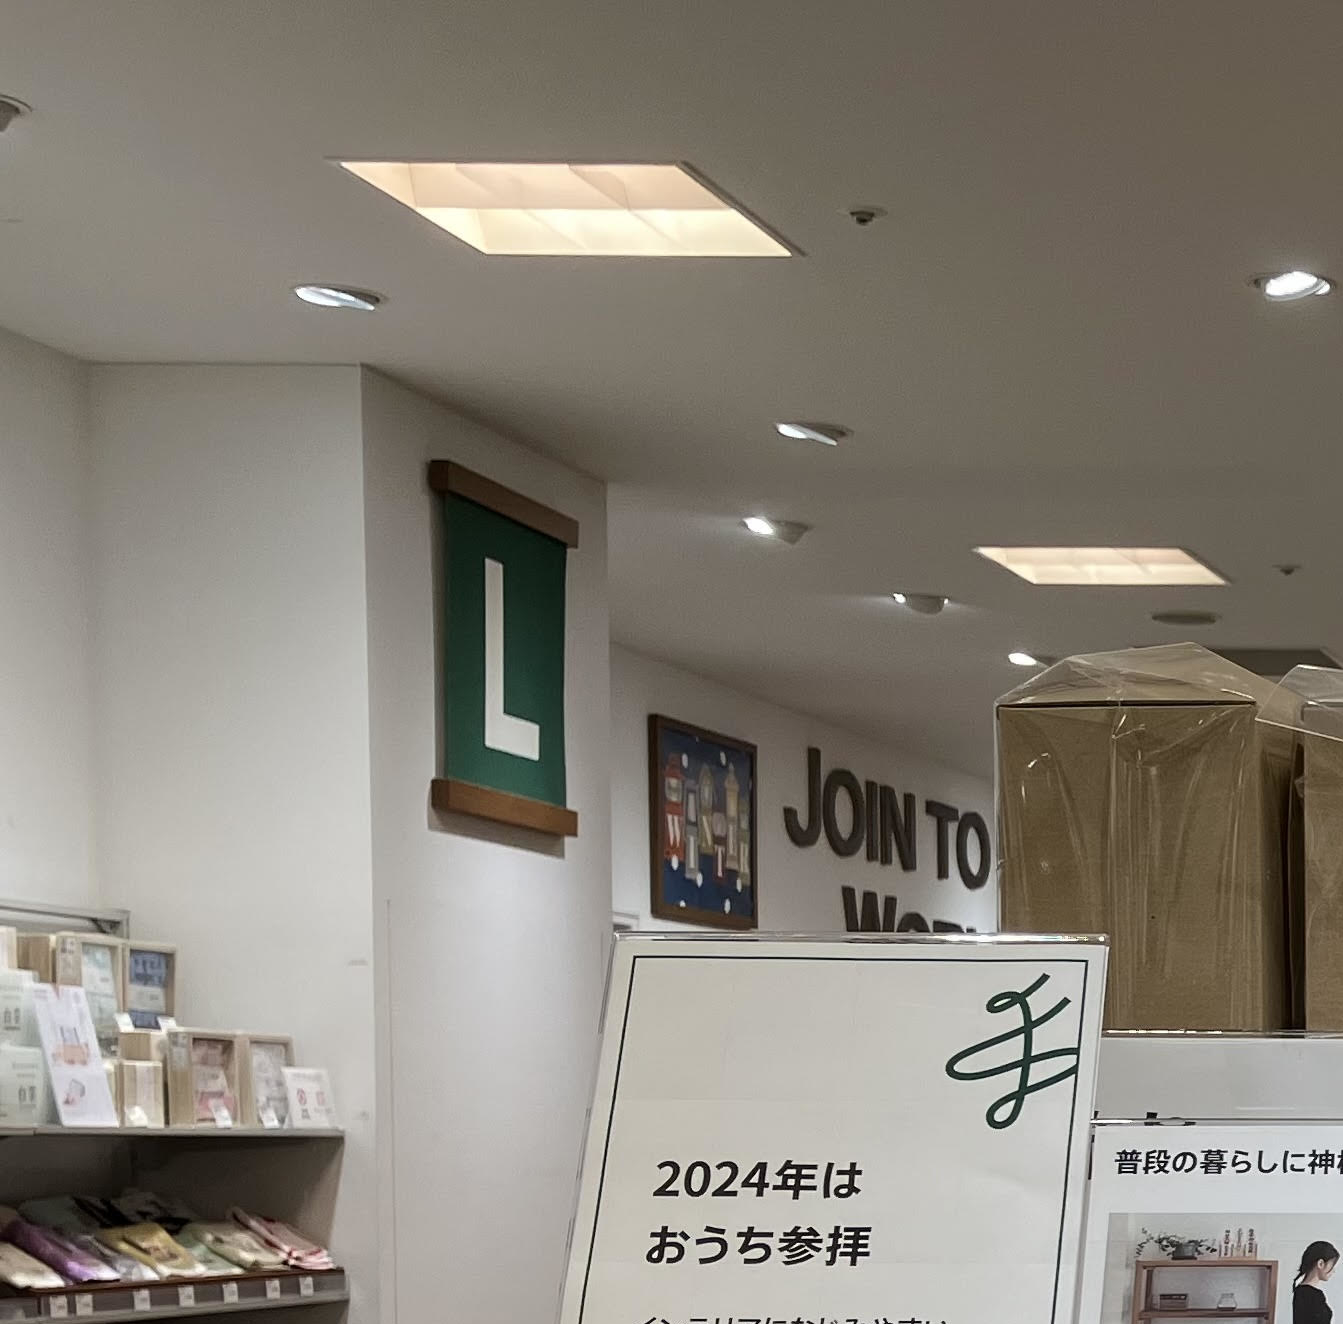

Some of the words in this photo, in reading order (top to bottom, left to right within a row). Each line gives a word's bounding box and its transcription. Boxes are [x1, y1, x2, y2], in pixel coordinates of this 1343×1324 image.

[485, 557, 540, 762] L
[783, 746, 917, 872] JOIN
[925, 798, 991, 890] TO
[652, 1160, 864, 1201] 2024年は
[646, 1225, 872, 1268] おうち参拝
